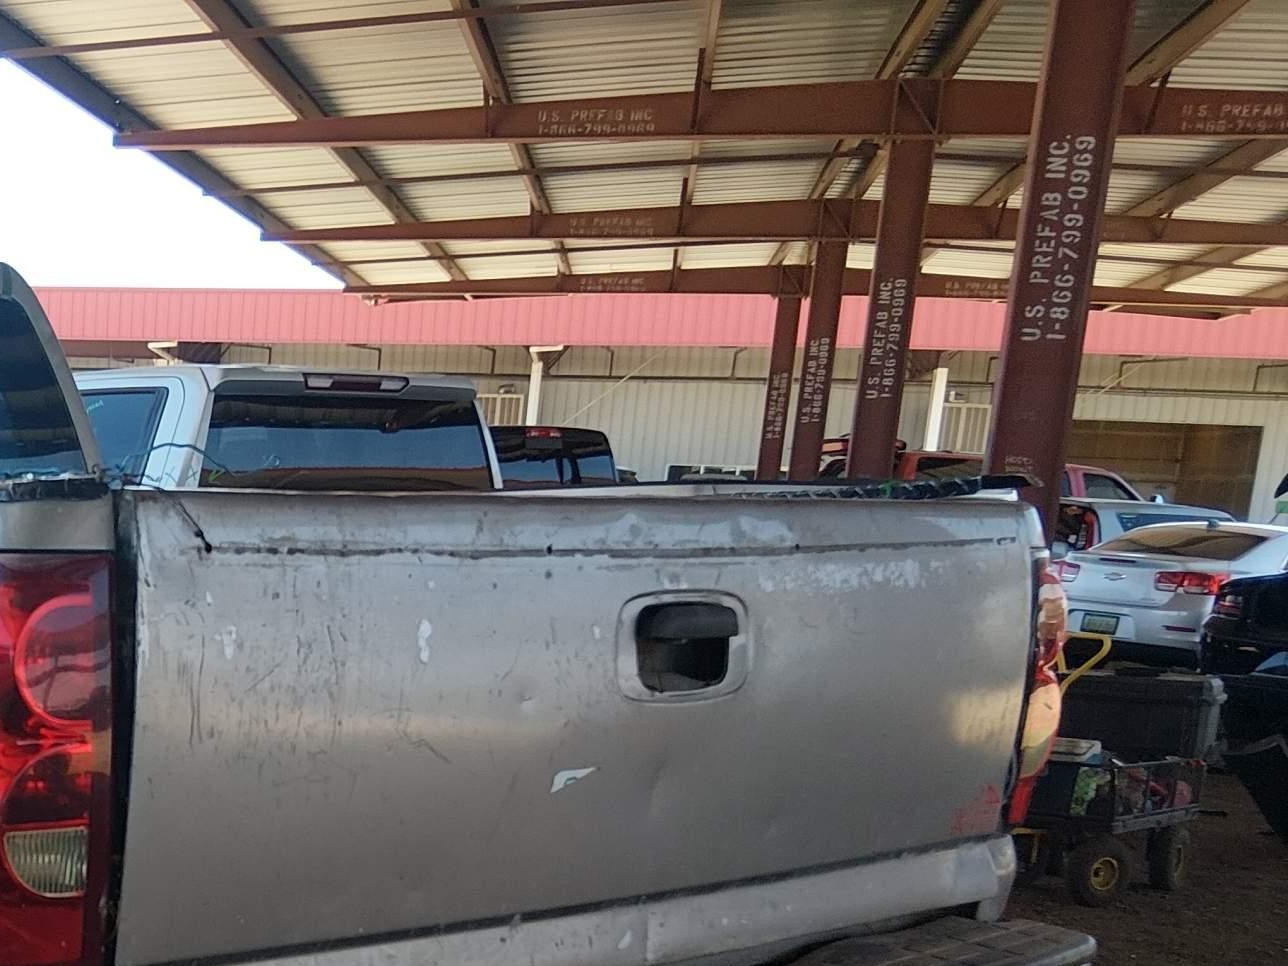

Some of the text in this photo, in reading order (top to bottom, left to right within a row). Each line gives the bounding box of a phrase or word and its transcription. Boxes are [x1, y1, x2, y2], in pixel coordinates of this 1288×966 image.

[570, 109, 624, 121] PREFB
[1020, 134, 1071, 341] U.S. PREFAB INC.
[1046, 136, 1096, 340] 1-866-799-0969
[869, 312, 888, 365] PREFAB
[865, 373, 881, 399] U.S.
